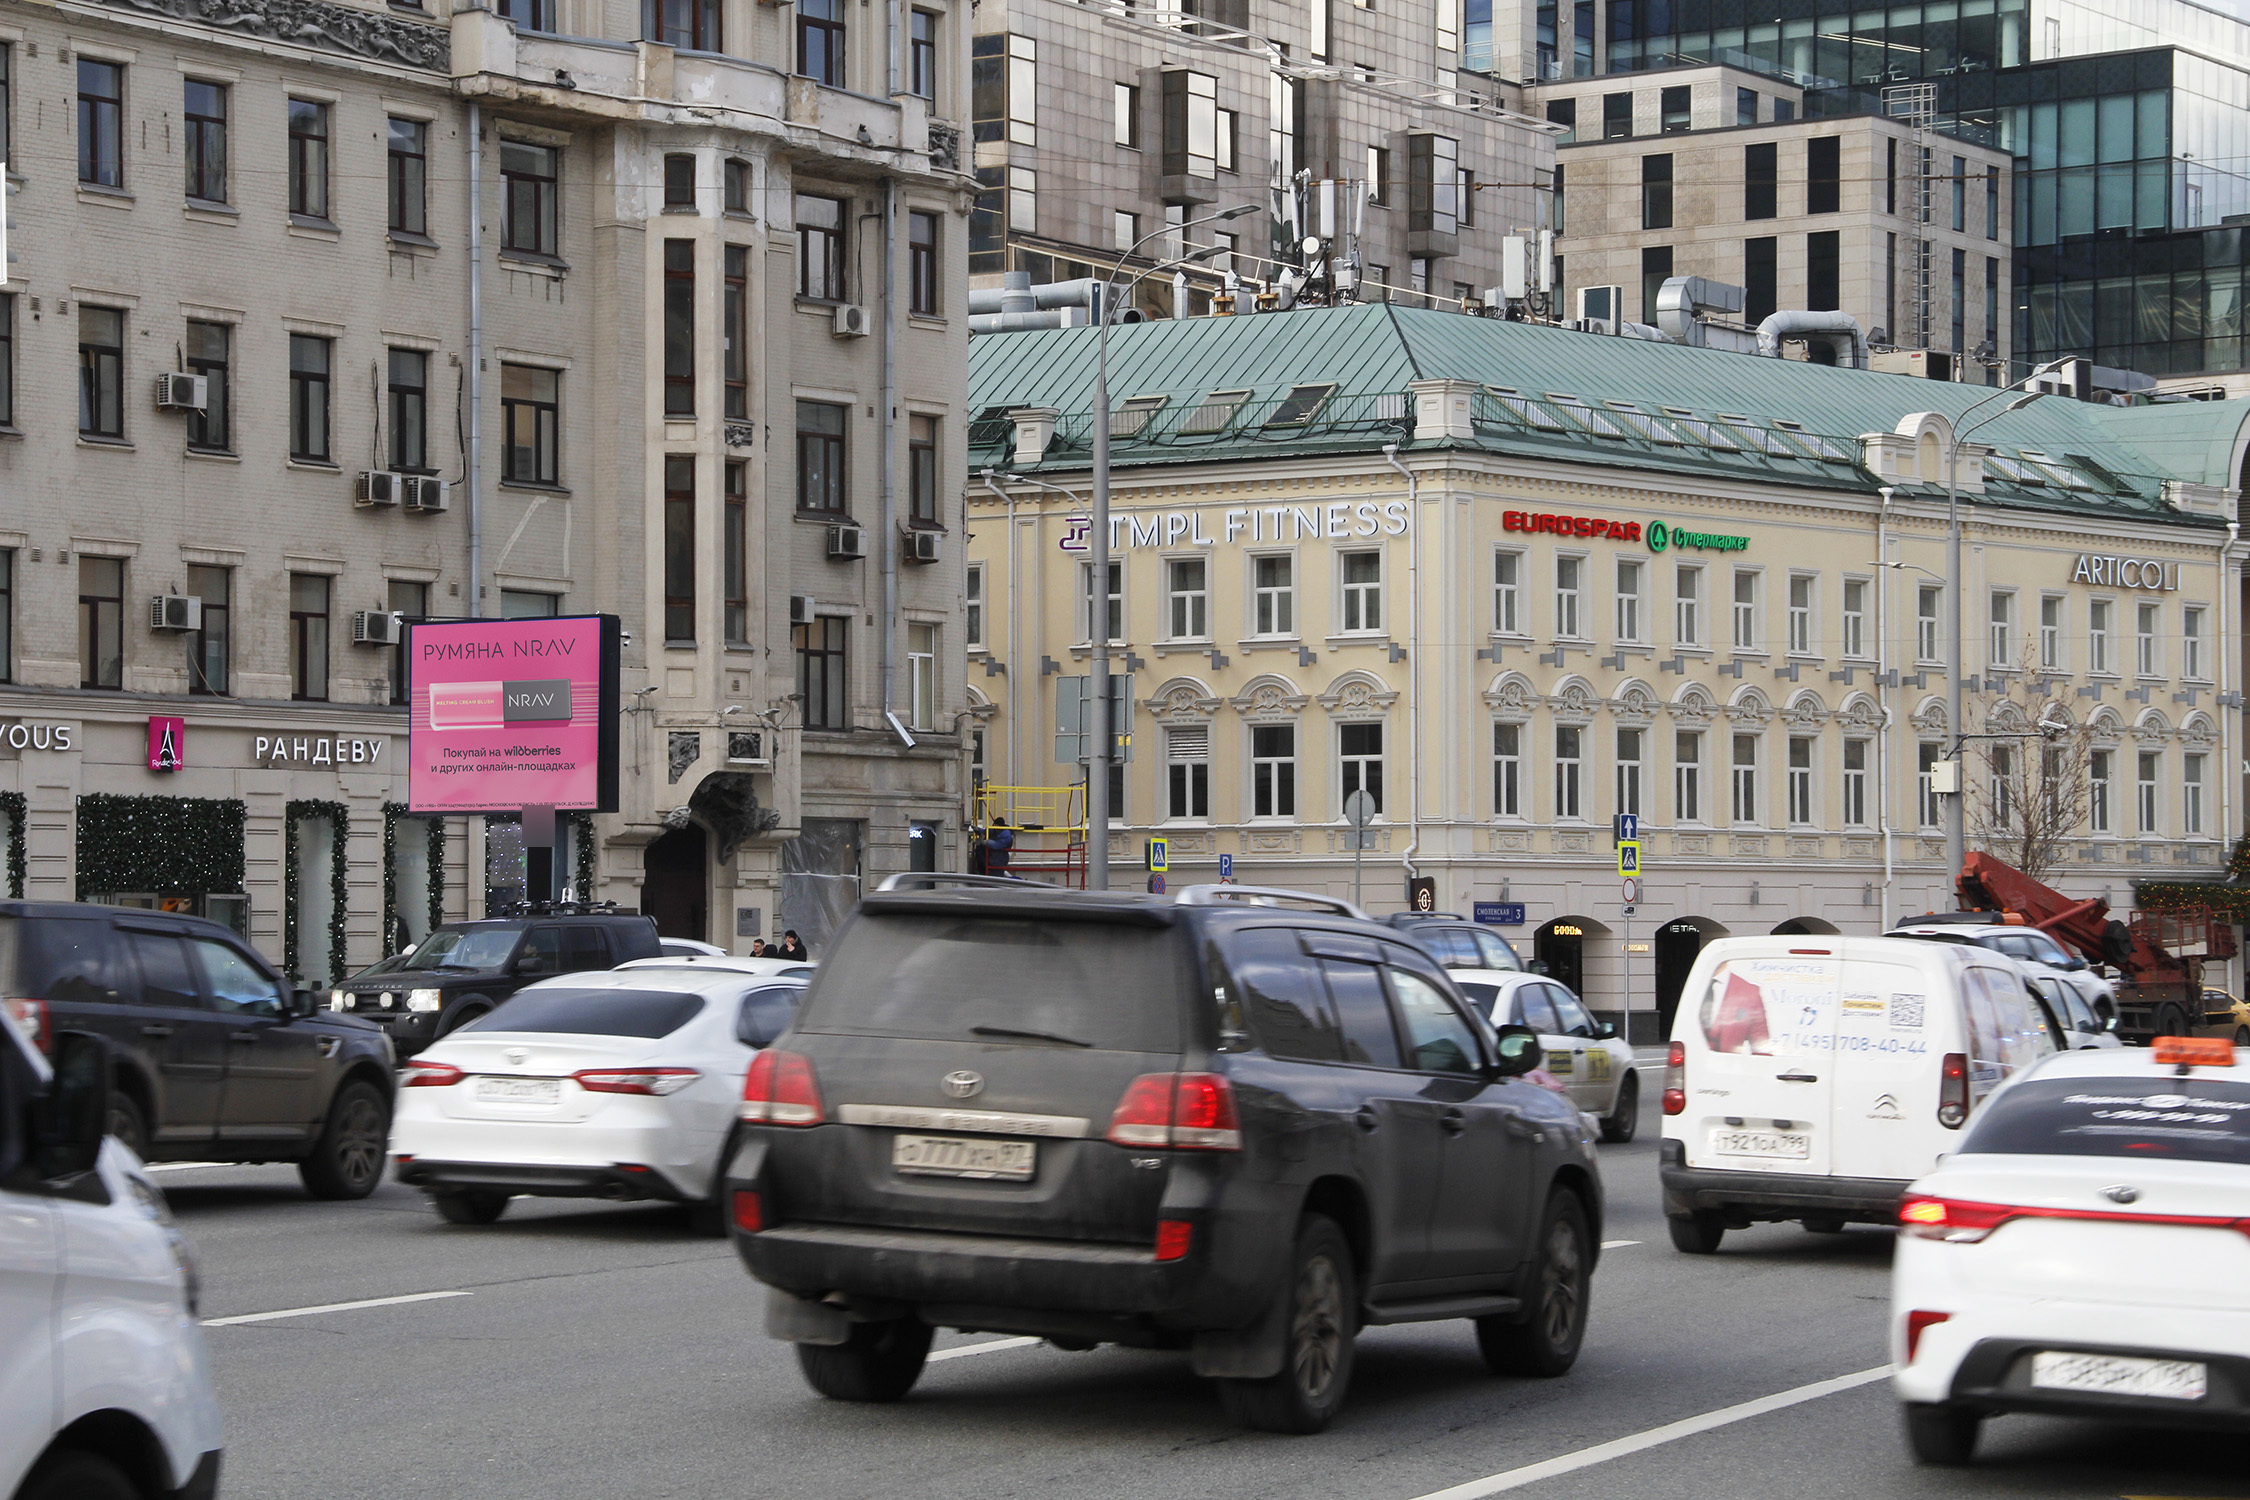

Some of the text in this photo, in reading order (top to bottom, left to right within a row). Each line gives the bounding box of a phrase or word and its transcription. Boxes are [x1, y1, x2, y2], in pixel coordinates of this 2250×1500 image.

[1109, 501, 1408, 549] TMPL FITNESS
[1502, 510, 1642, 542] EUROSPAR
[1673, 527, 1750, 553] Супермаркет
[2073, 555, 2181, 592] ARTICOLI
[424, 641, 504, 661] РУМЯНА
[0, 724, 71, 750] OUS
[256, 736, 382, 765] РАНДЕВУ
[443, 745, 561, 759] Покупай на wildberries
[431, 761, 576, 774] и других онлайн-площадках
[1476, 908, 1510, 916] СМОЛЕНСКАЯ
[1515, 909, 1521, 920] 3
[1840, 1036, 1927, 1053] 708-40-44
